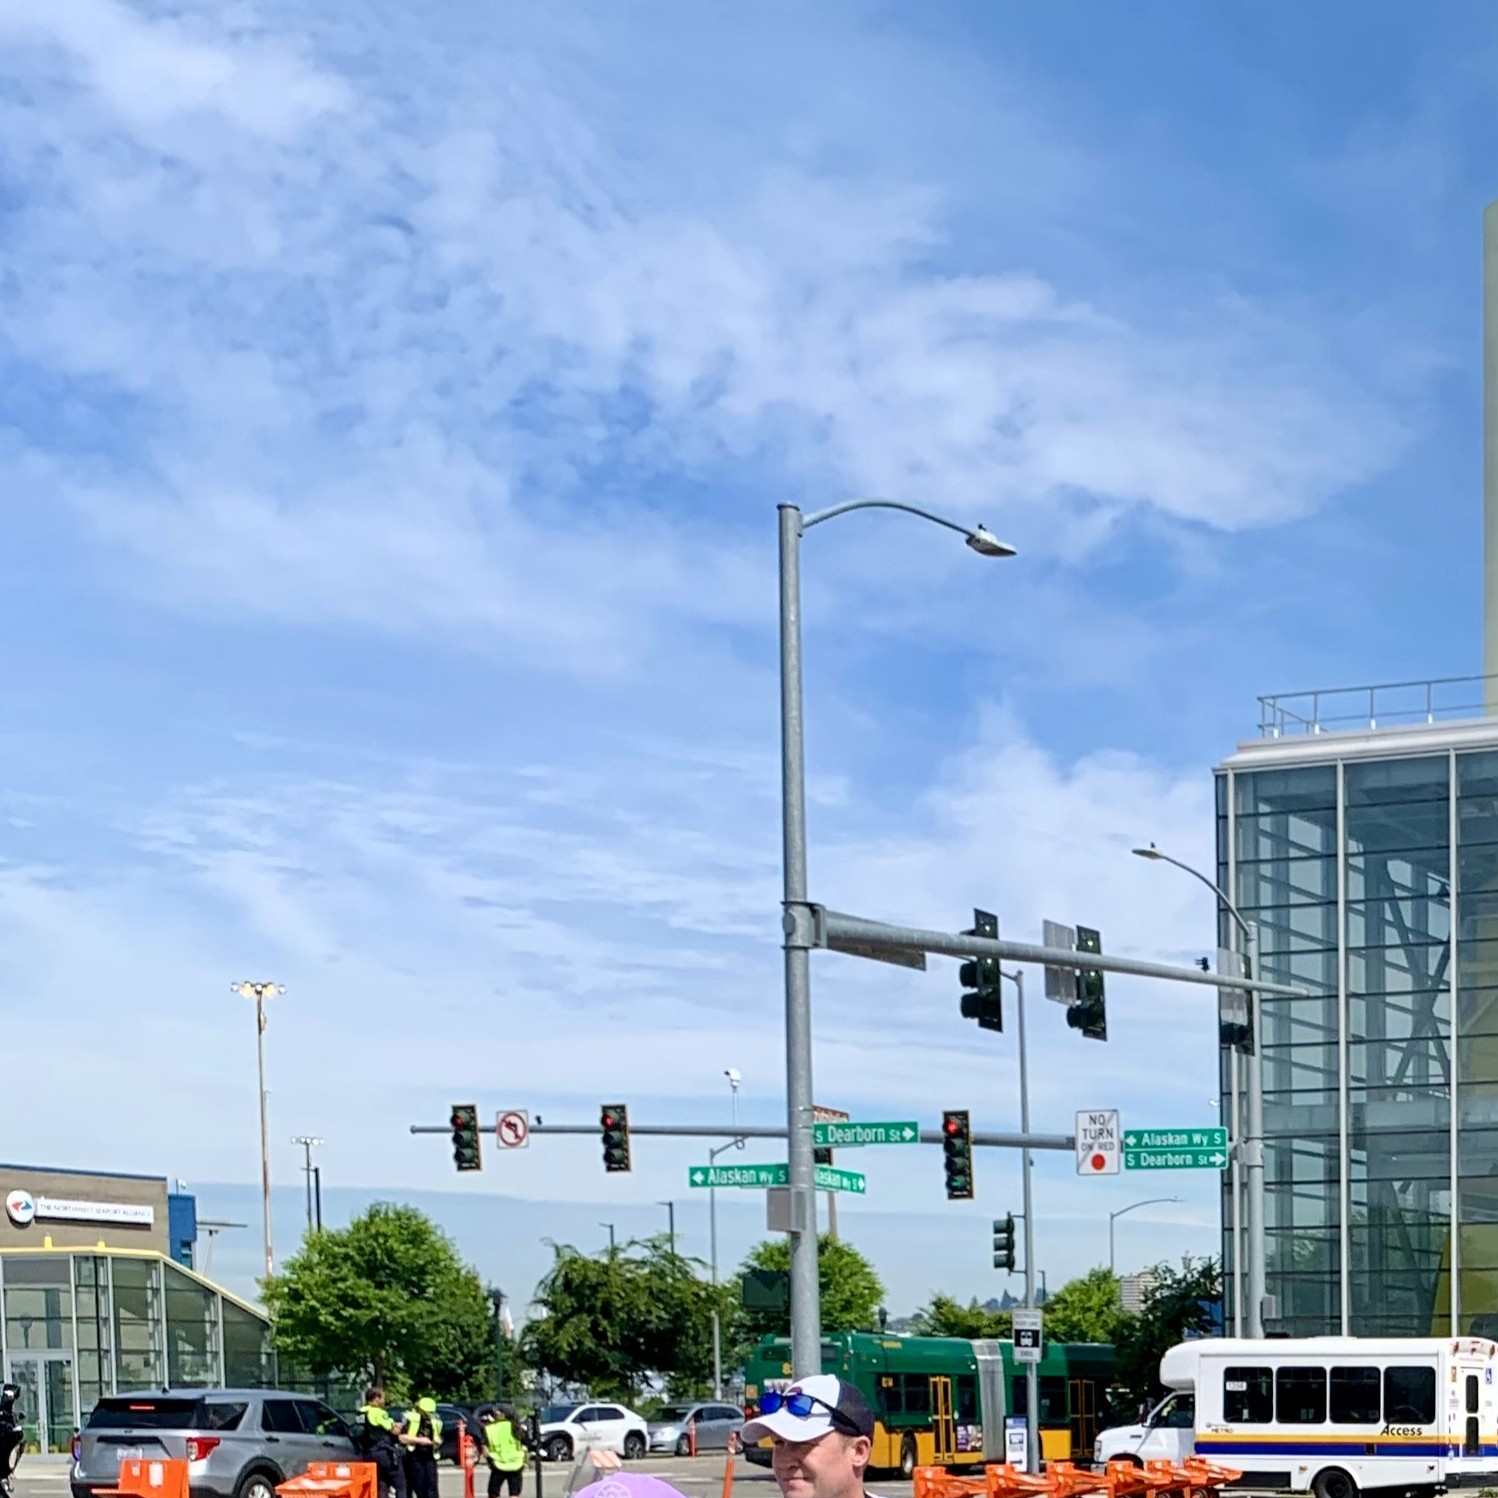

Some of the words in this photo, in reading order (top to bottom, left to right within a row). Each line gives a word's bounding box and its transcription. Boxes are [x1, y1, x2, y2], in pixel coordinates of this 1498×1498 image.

[1089, 1114, 1106, 1126] NO
[816, 1130, 823, 1143] S
[828, 1125, 885, 1142] Dearborn
[889, 1129, 900, 1142] St
[1082, 1128, 1114, 1140] TURN
[1141, 1132, 1188, 1146] Alaskan
[1192, 1133, 1209, 1146] Wy
[1213, 1132, 1222, 1144] S
[1081, 1143, 1094, 1151] ON
[1098, 1142, 1115, 1151] RED
[1127, 1154, 1135, 1166] S
[1140, 1152, 1193, 1167] Dearborn
[1198, 1154, 1208, 1165] St
[707, 1168, 757, 1185] Alaskan
[759, 1170, 773, 1184] Wy
[778, 1170, 786, 1182] S
[1380, 1423, 1423, 1436] Access
